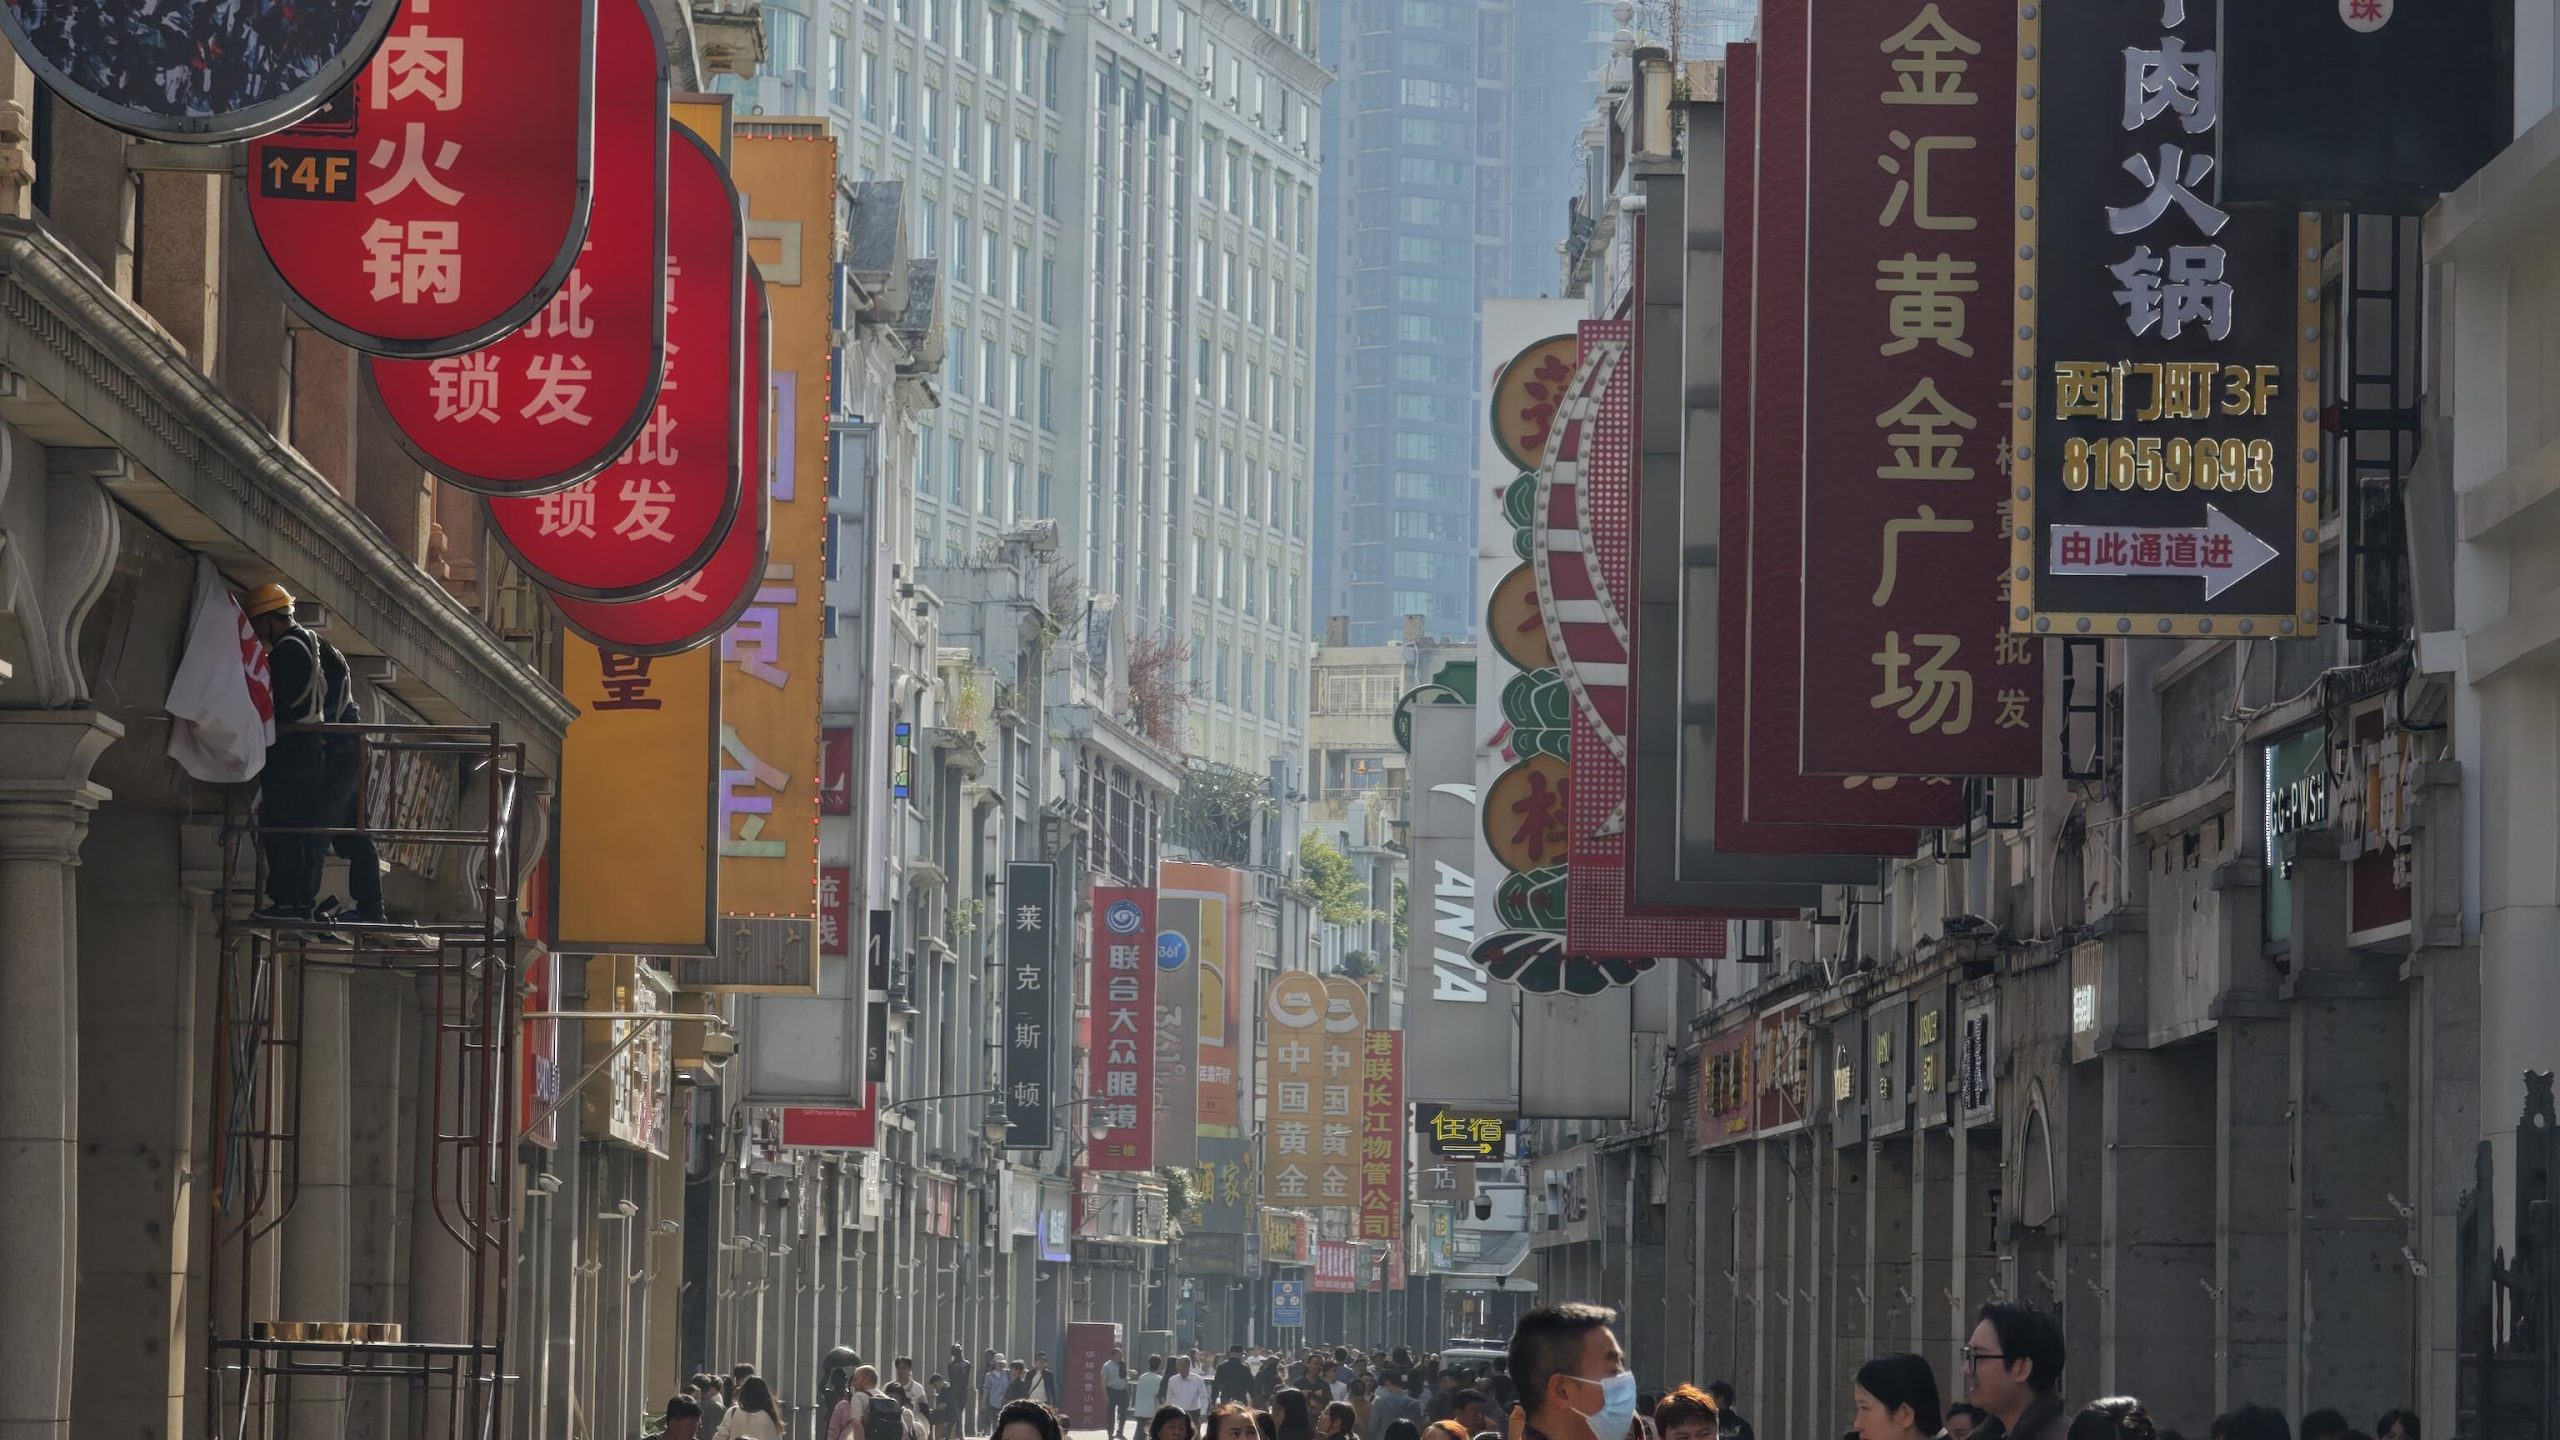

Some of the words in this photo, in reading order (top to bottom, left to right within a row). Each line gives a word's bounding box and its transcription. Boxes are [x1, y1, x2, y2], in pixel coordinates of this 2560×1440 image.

[291, 157, 350, 194] 4F
[361, 0, 466, 304] 肉火锅
[2105, 0, 2233, 340] 肉火锅
[1870, 3, 1982, 735] 金汇黄金广场
[2055, 359, 2219, 421] 西门町
[2221, 365, 2280, 416] 3F
[2061, 531, 2233, 569] 由此通道进
[2063, 437, 2274, 493] 81659693
[1013, 904, 1042, 1108] 莱克斯顿
[1107, 944, 1140, 1129] 联合大众眼镜
[1275, 1039, 1310, 1198] 中国黄金
[1363, 1032, 1394, 1238] 港联长江物管公司
[1431, 1111, 1503, 1142] 住宿
